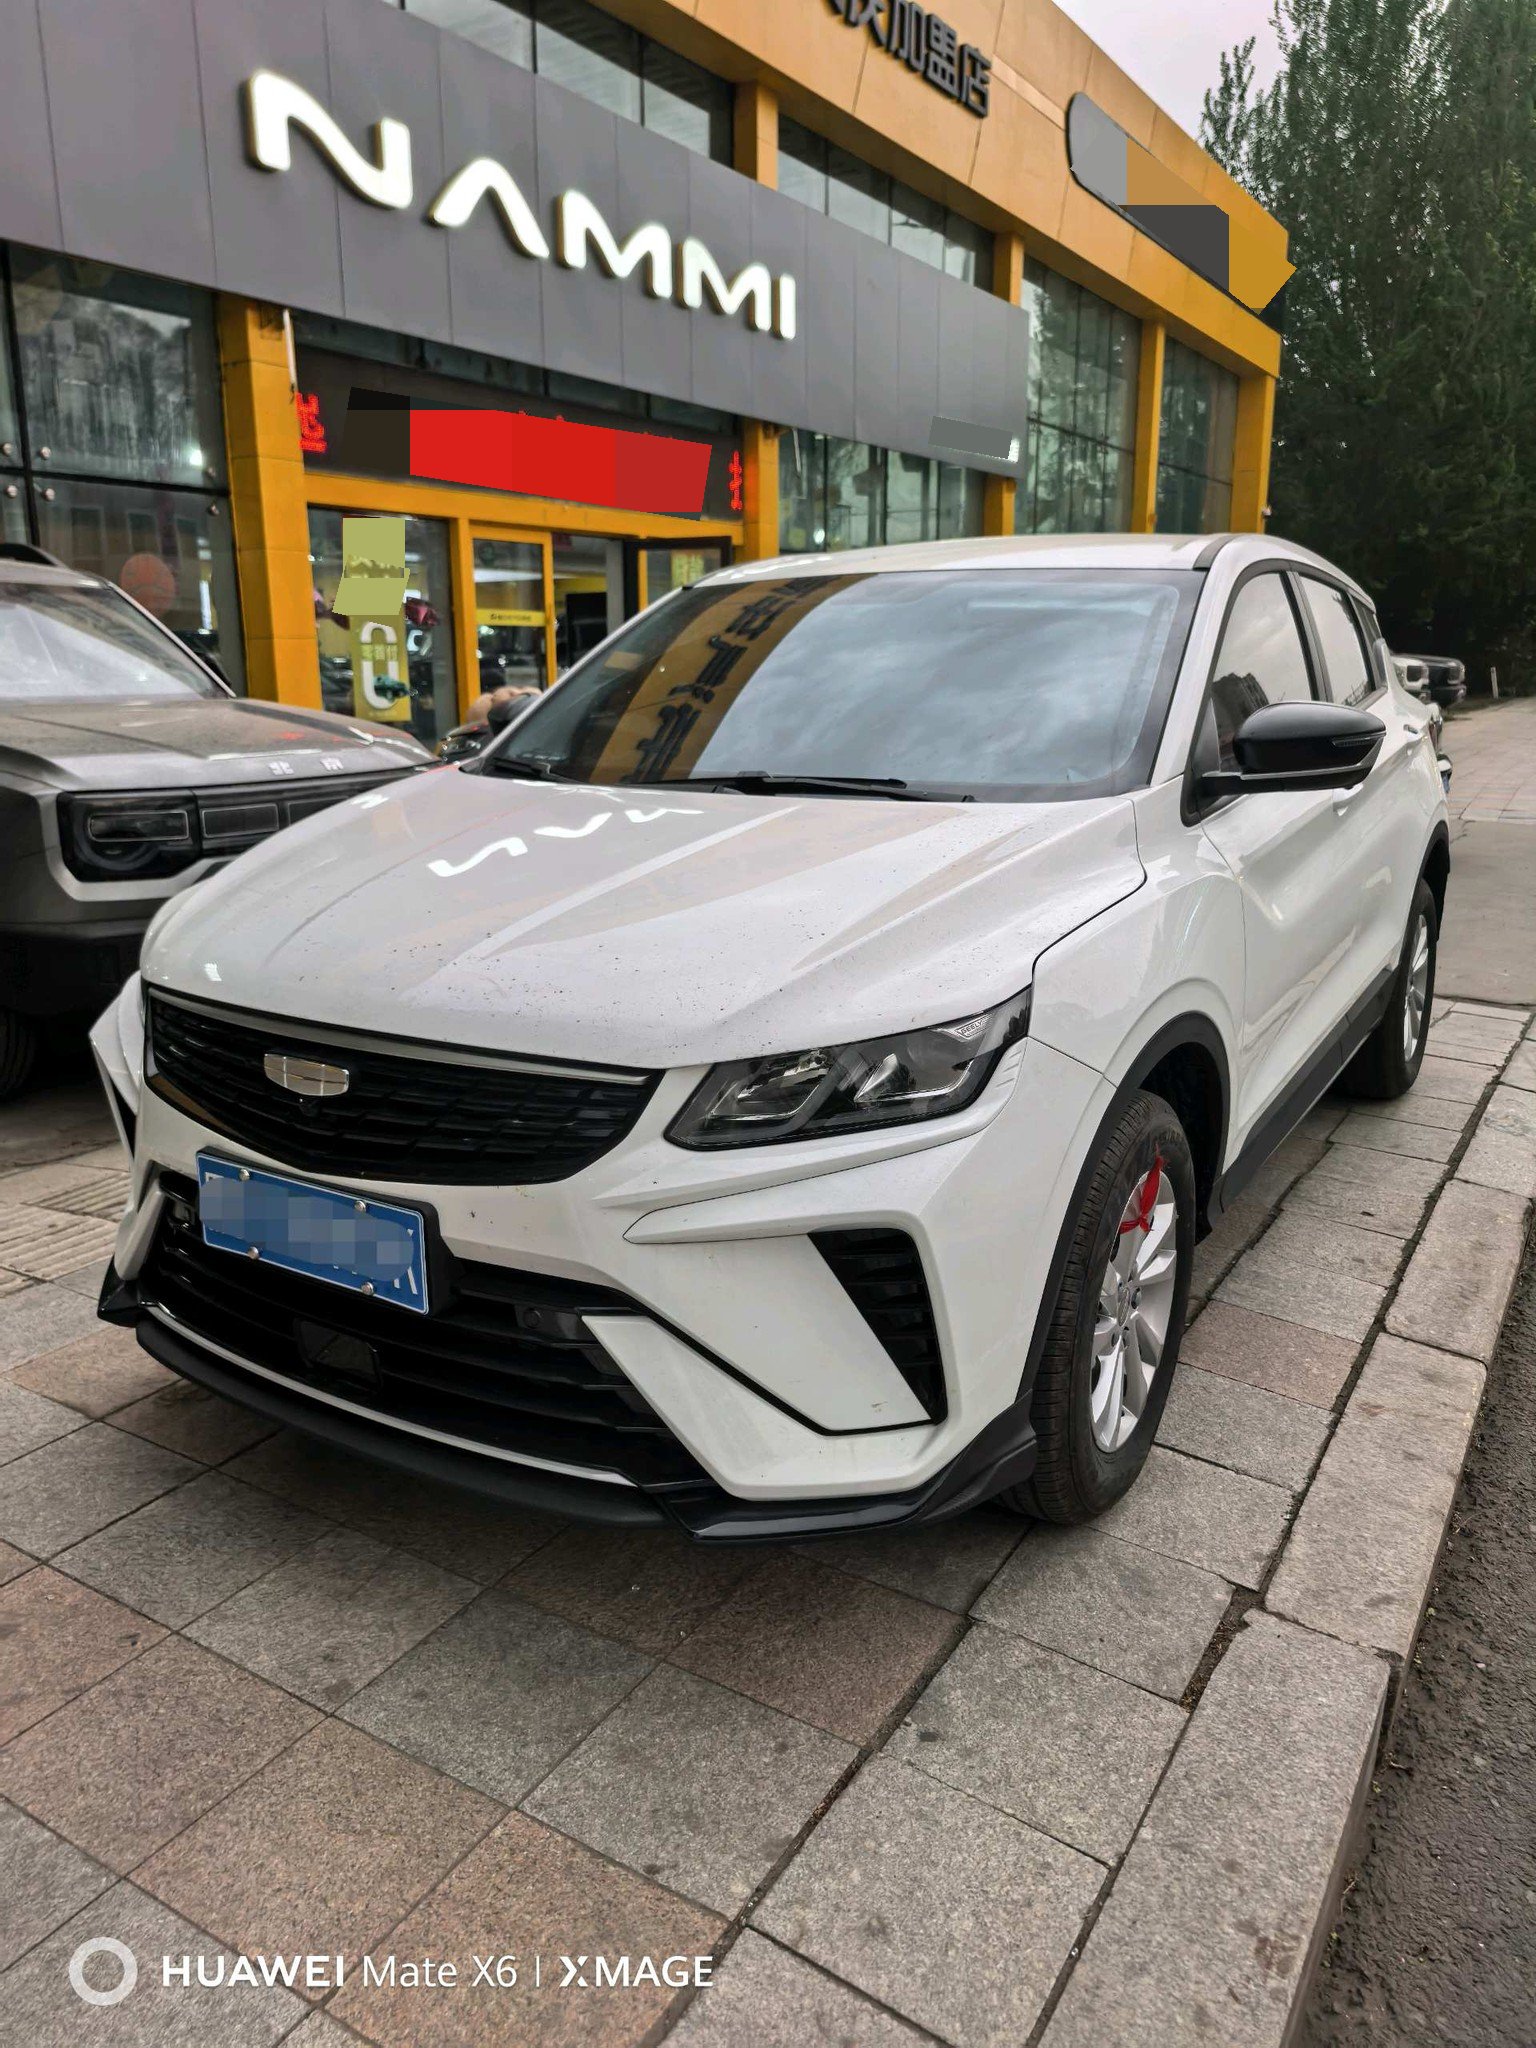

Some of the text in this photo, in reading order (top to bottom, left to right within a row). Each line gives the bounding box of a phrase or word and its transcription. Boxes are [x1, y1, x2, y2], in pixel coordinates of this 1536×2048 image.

[822, 0, 992, 118] 加盟店
[249, 69, 797, 341] NAMMI
